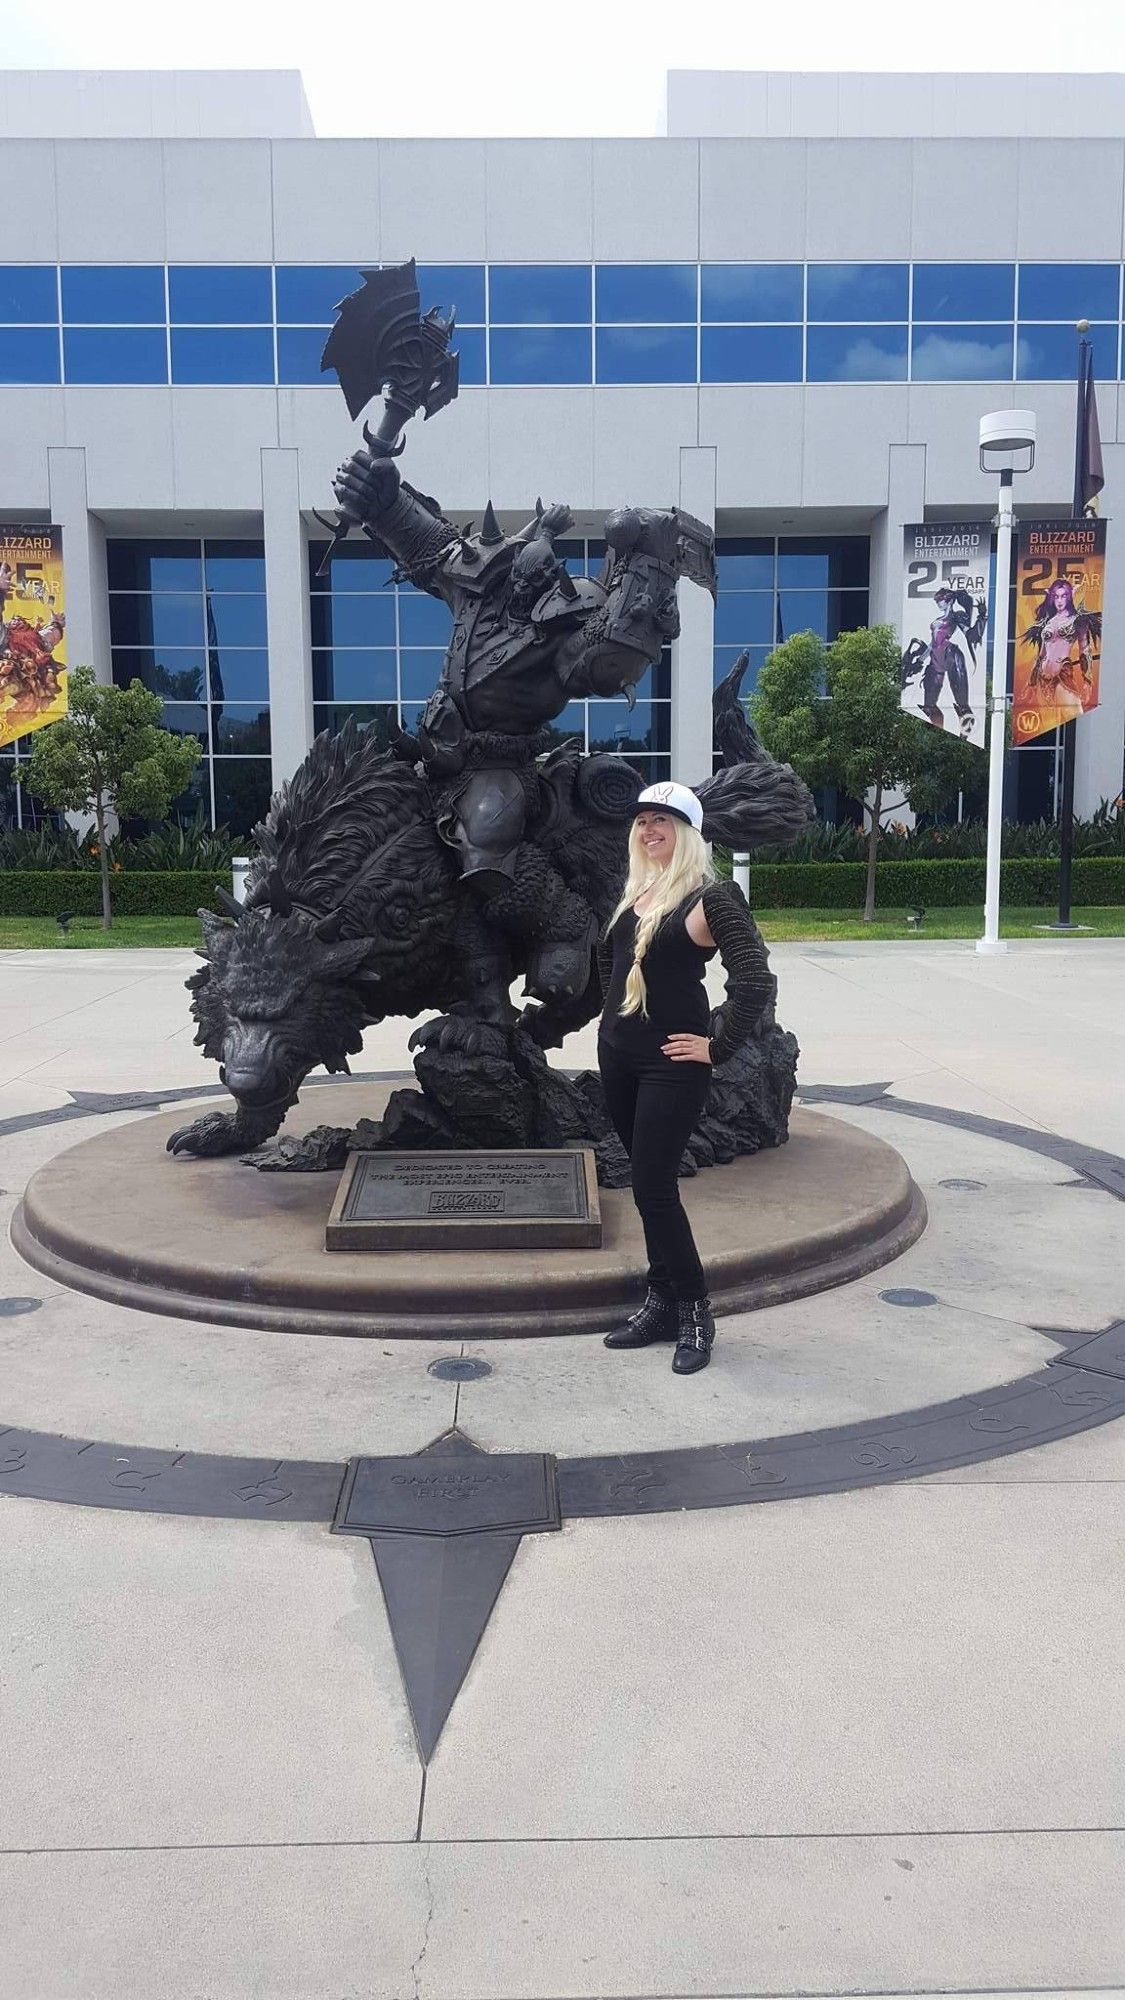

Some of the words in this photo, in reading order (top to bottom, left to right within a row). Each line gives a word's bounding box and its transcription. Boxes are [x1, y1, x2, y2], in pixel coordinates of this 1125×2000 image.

[914, 534, 979, 548] BLIZZARD
[1029, 531, 1095, 543] BLIZZARD
[914, 546, 979, 559] ENTERTAINMENT
[1029, 543, 1094, 555] ENTERTAINMENT
[908, 559, 969, 598] 25
[947, 576, 985, 589] YEAR
[1022, 557, 1085, 596] 25
[1062, 573, 1101, 586] YEAR
[391, 1474, 511, 1485] GAMEPLAY
[417, 1486, 480, 1500] FIRST
